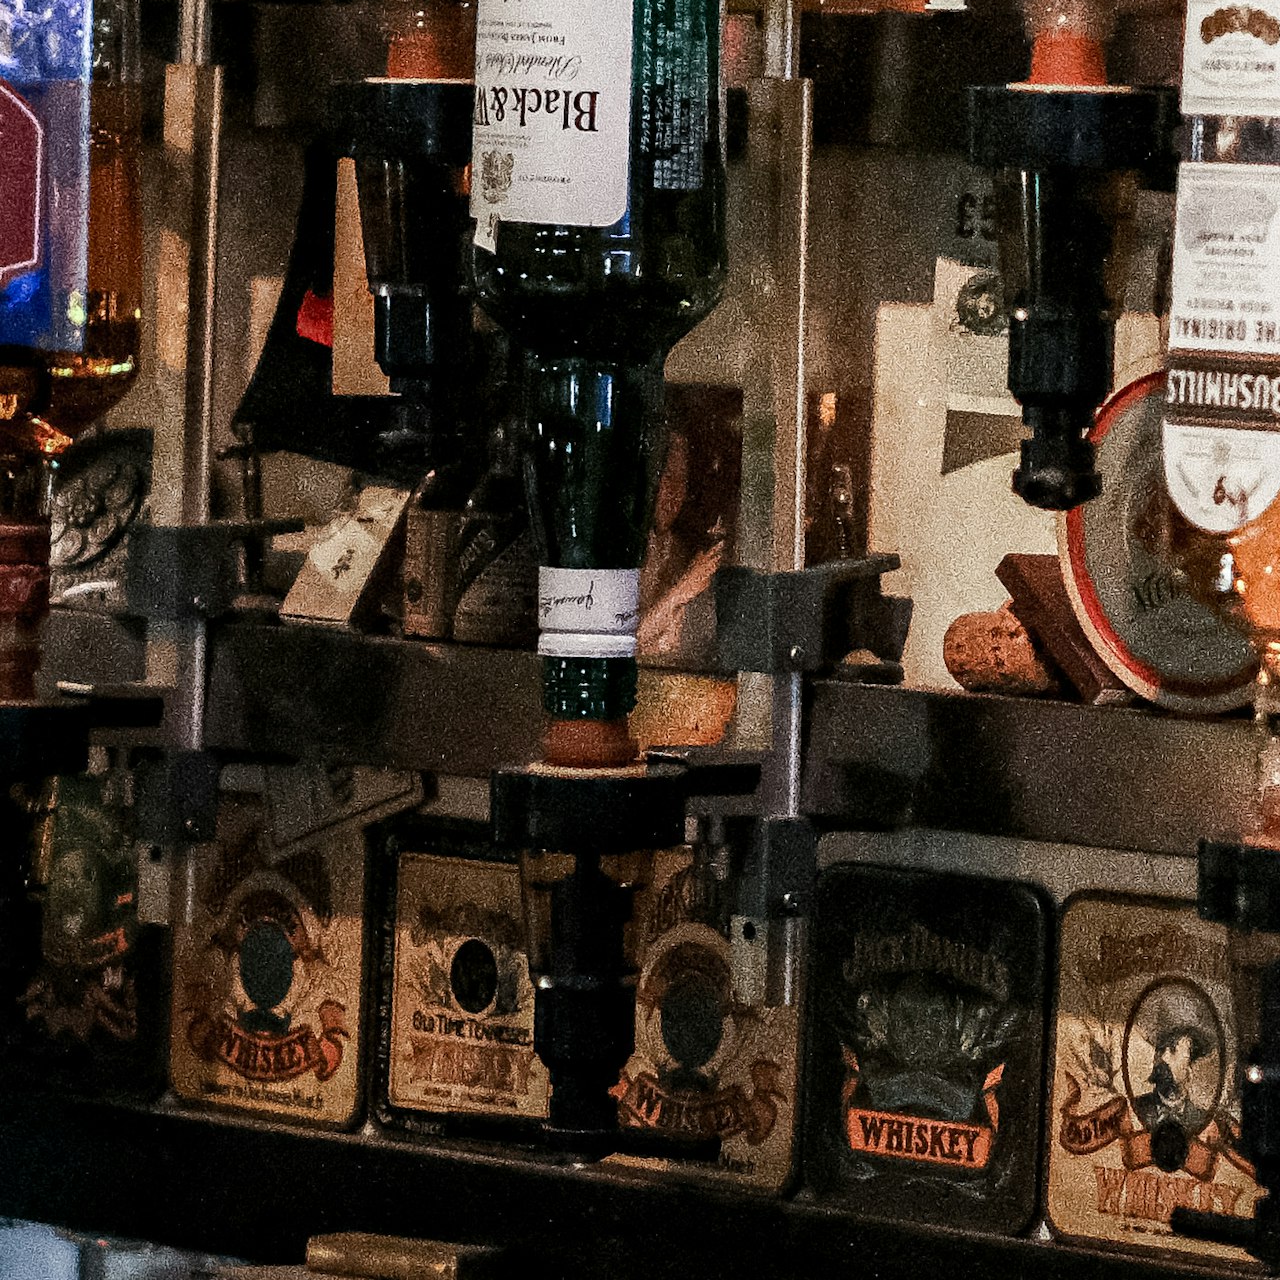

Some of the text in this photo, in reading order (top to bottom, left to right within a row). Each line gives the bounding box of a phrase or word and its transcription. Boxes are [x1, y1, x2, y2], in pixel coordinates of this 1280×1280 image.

[490, 86, 508, 123] &
[511, 86, 600, 132] Black
[1174, 315, 1247, 342] ORIGINAL
[859, 1114, 980, 1162] WHISKEY
